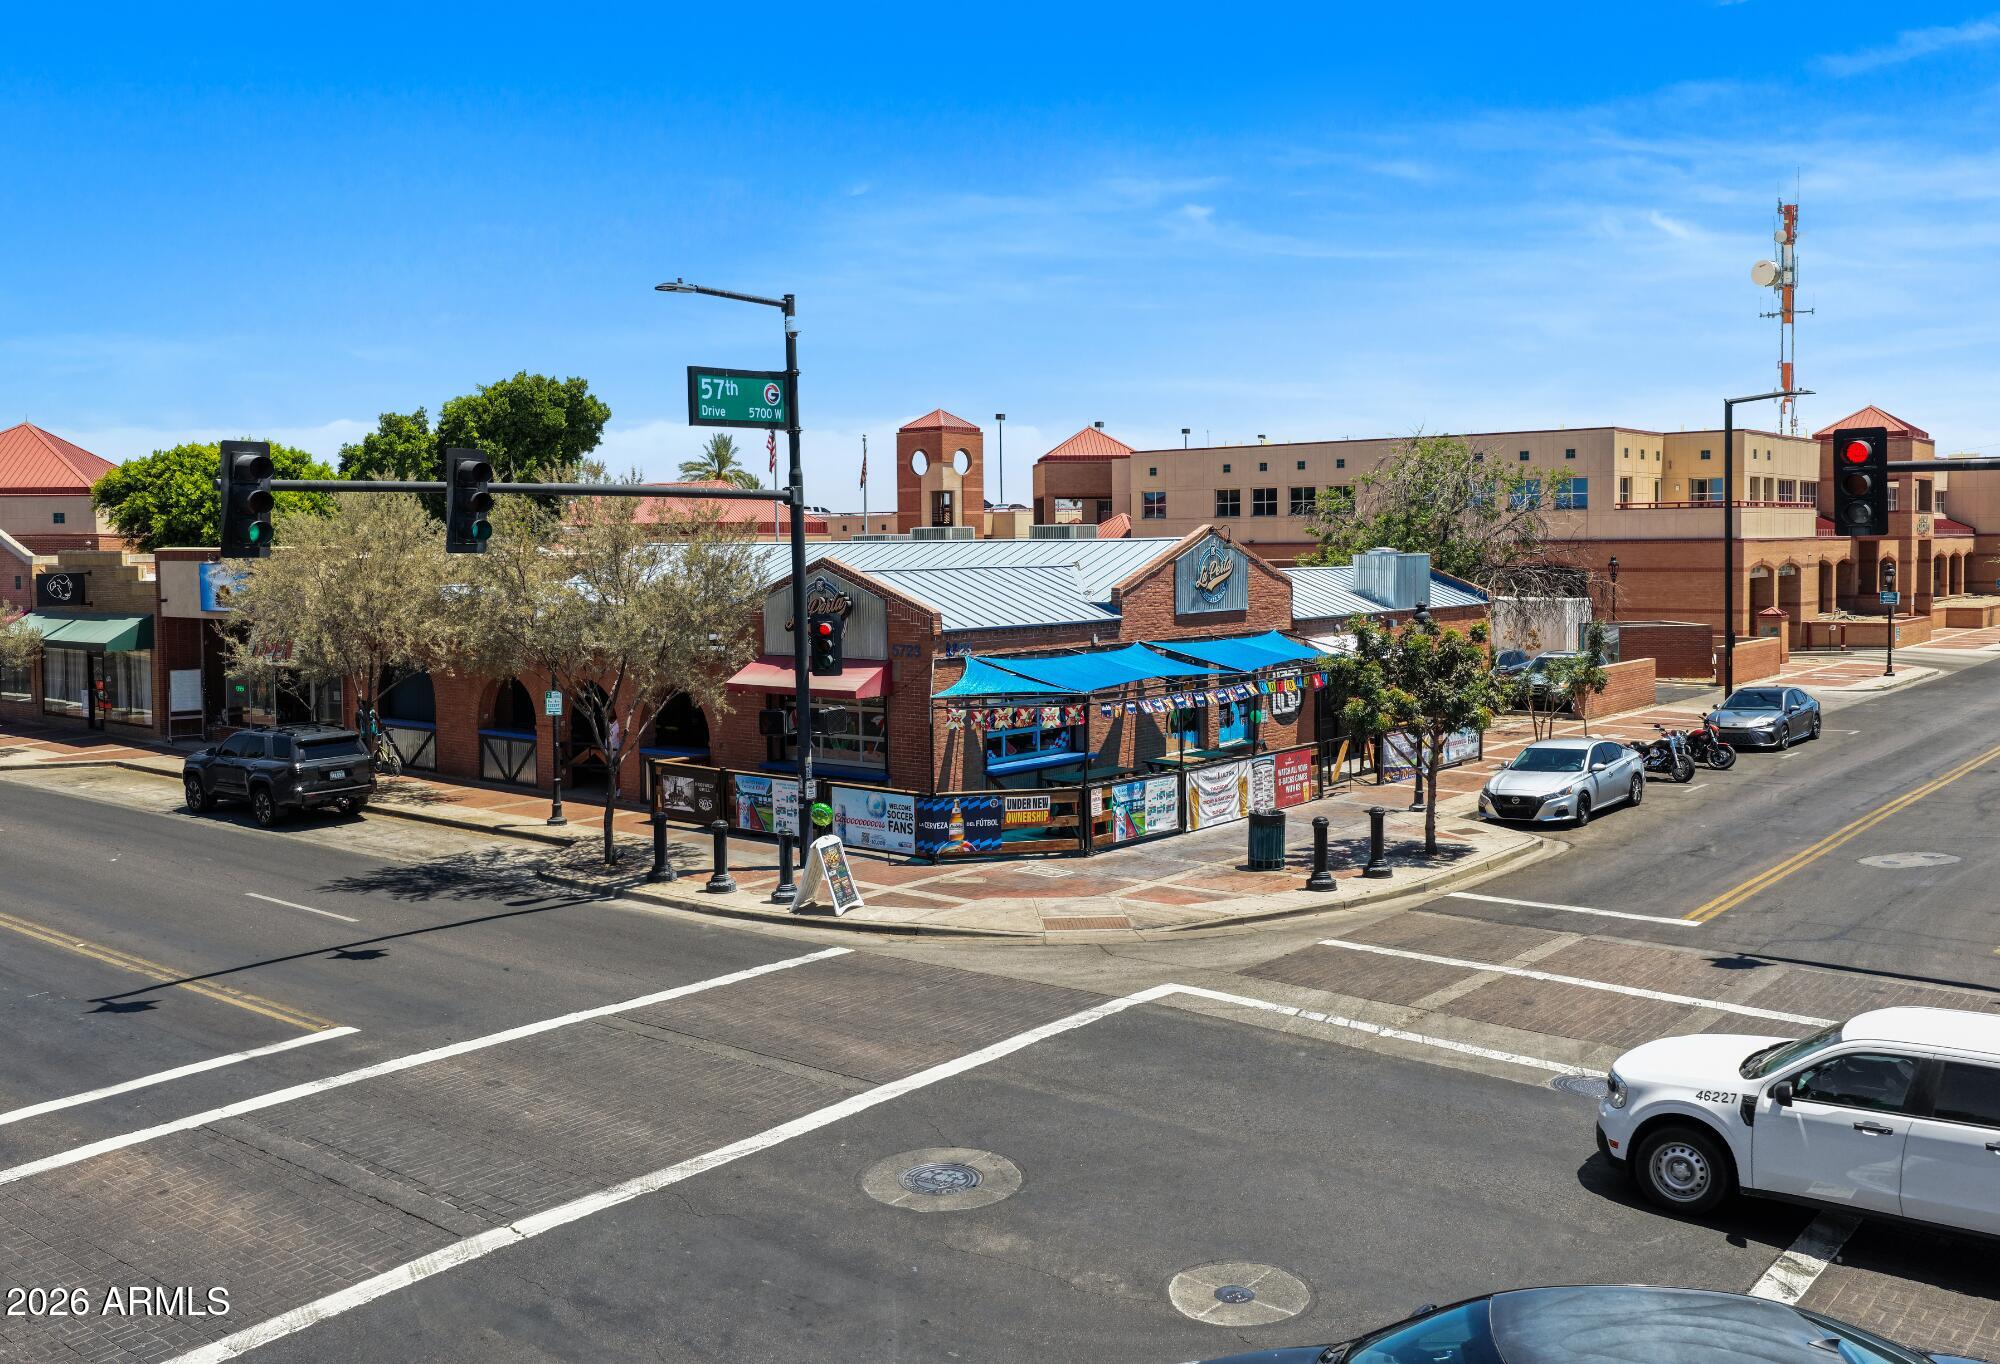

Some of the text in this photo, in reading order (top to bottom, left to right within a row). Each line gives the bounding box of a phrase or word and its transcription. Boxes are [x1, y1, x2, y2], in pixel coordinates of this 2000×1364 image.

[701, 378, 738, 400] 57th
[702, 405, 726, 417] Drive
[749, 408, 782, 419] 5700 W
[1196, 565, 1208, 588] La
[889, 803, 912, 811] WELCOME
[1007, 797, 1049, 810] UNDER NEW
[887, 810, 914, 821] SOCCER
[1006, 811, 1049, 823] OWNERSHIP
[888, 820, 914, 835] FANS
[924, 821, 948, 829] CERVEZA
[976, 818, 999, 827] FÚTBOL
[1695, 1090, 1738, 1104] 46227
